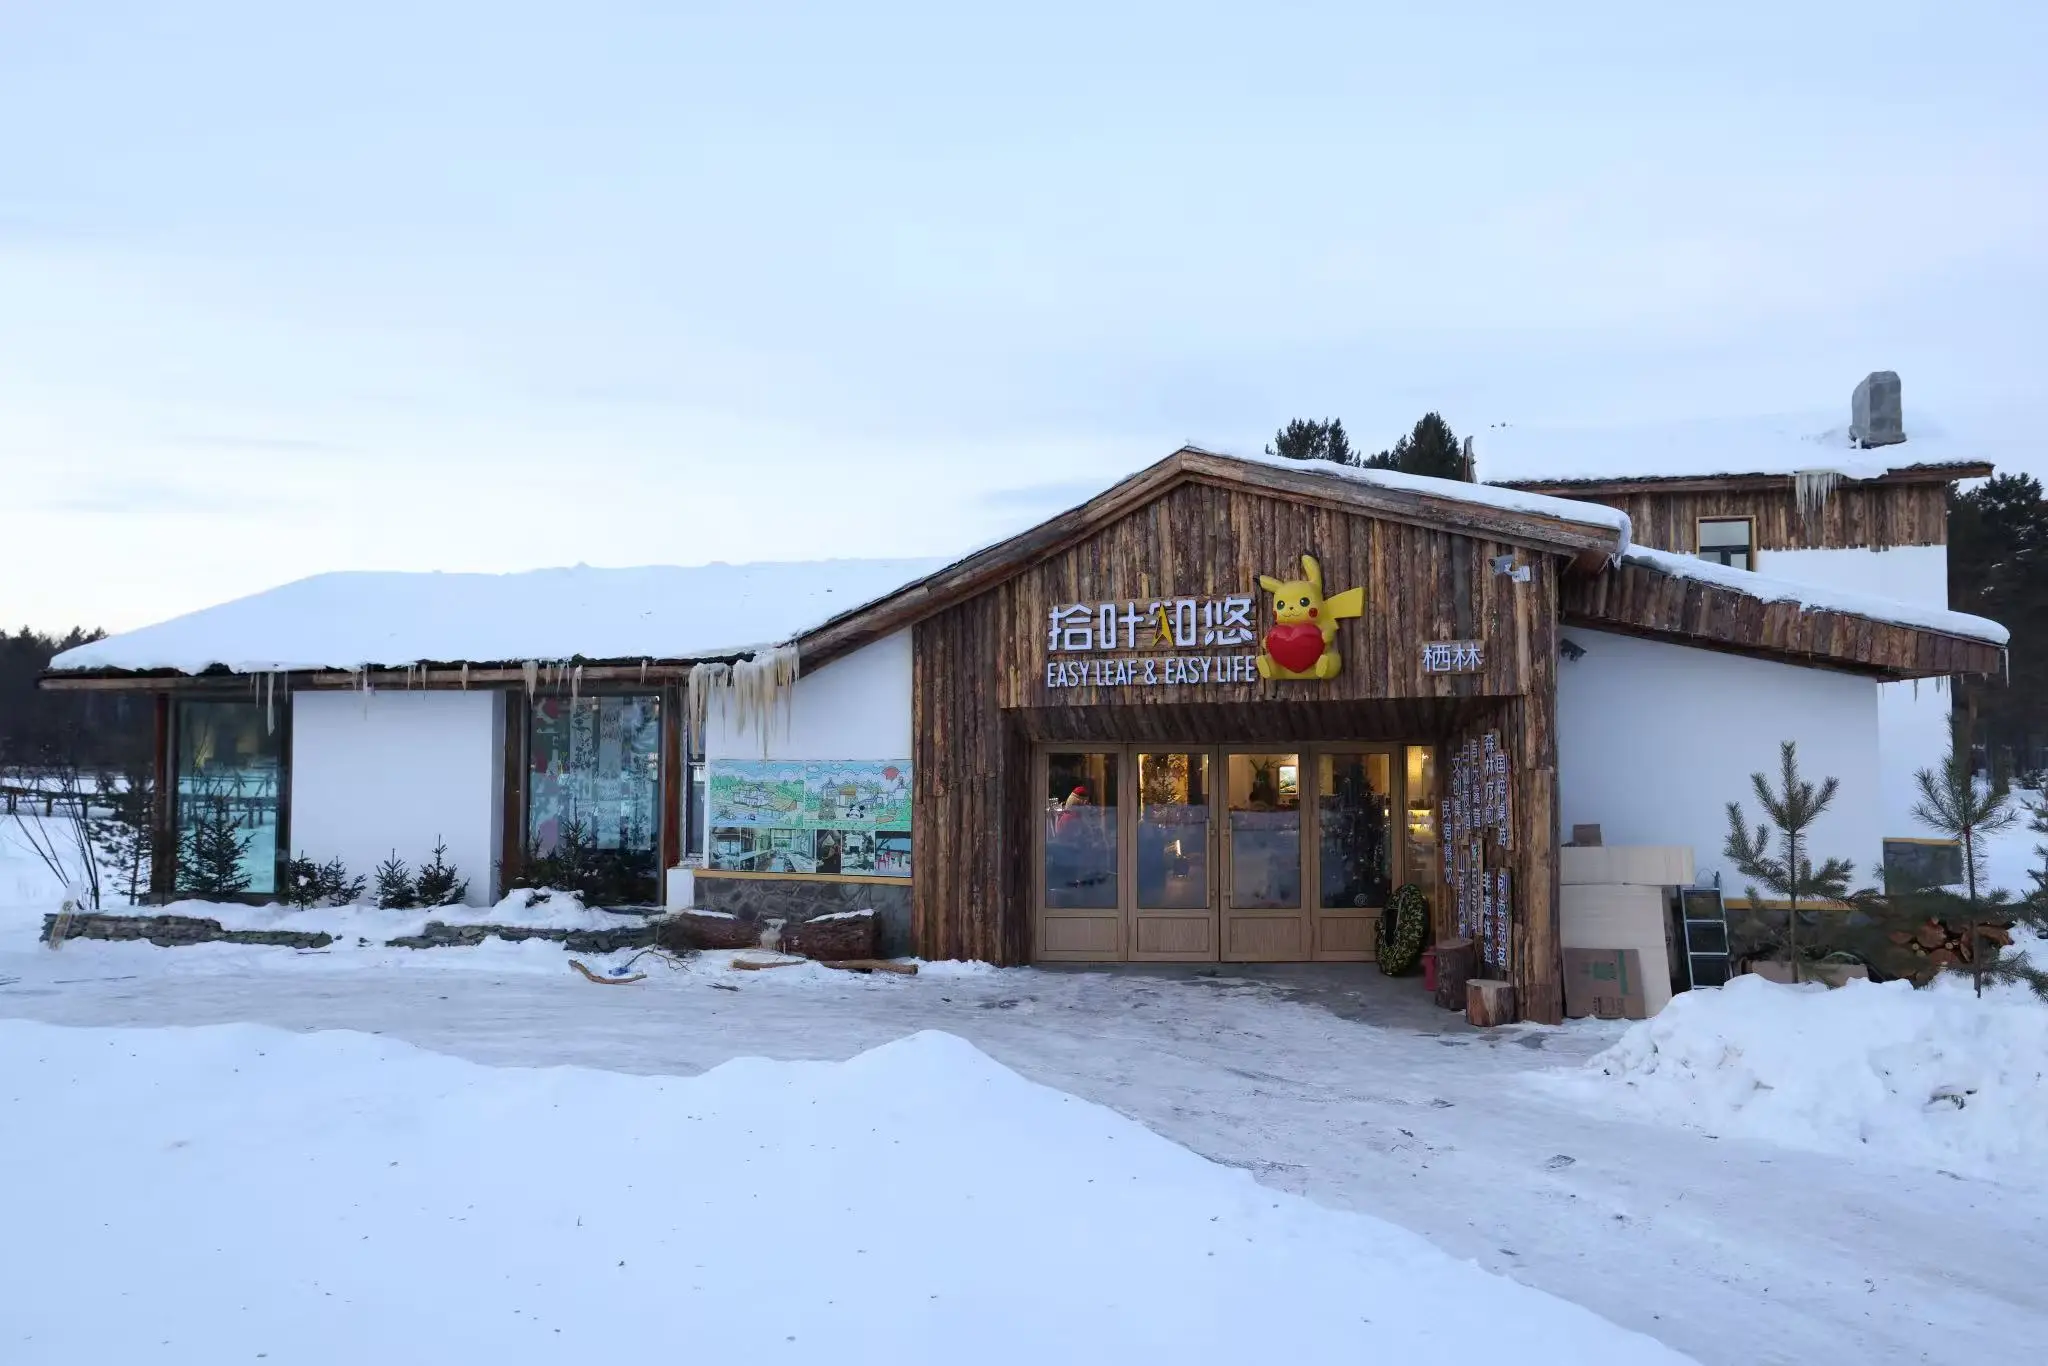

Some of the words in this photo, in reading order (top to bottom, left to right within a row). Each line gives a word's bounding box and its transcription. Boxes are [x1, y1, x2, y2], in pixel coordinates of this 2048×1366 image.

[1047, 661, 1089, 688] EASY
[1096, 659, 1137, 686] LEAF
[1143, 659, 1158, 684] &
[1165, 657, 1211, 685] EASY
[1217, 655, 1256, 683] LIFE
[1422, 642, 1483, 673] 栖林
[1483, 732, 1497, 825] 森林疗愈
